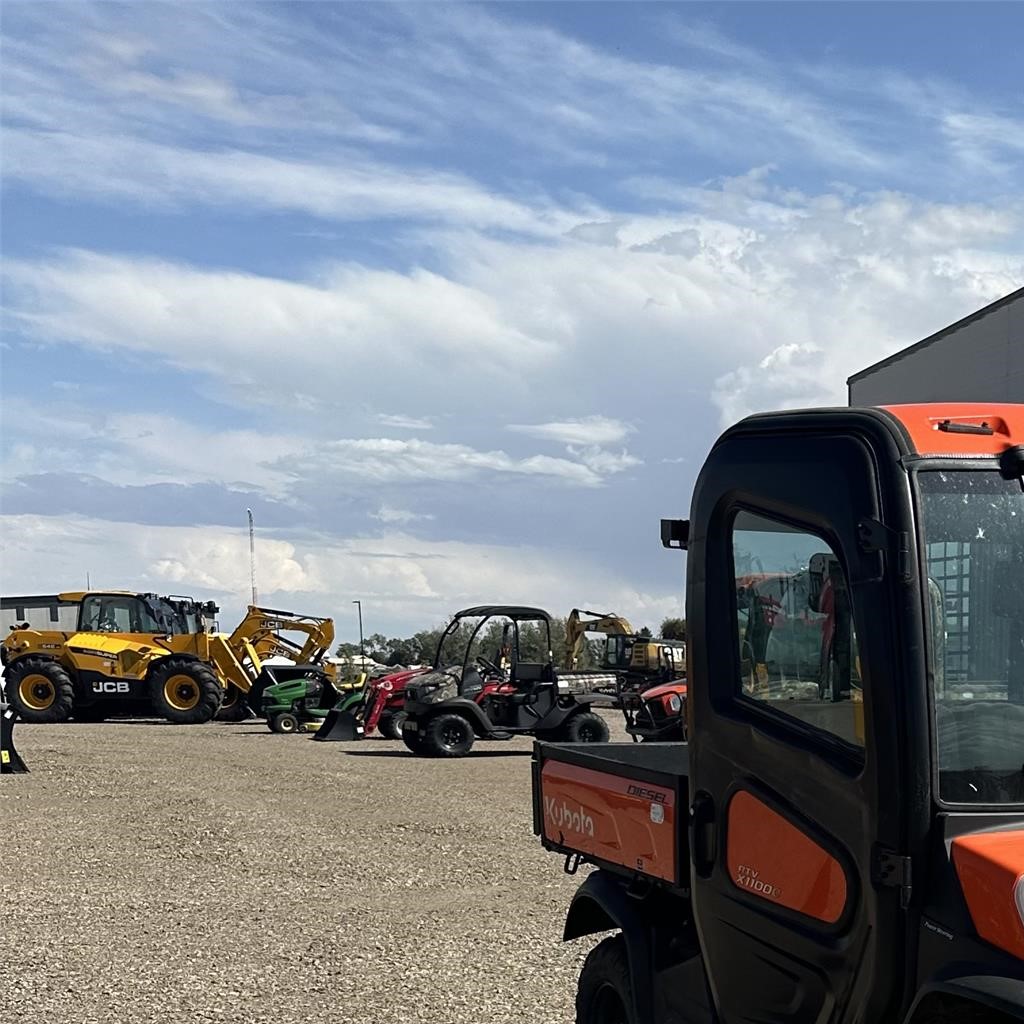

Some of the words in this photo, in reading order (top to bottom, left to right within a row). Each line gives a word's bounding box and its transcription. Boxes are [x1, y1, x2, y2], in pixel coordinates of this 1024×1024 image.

[92, 682, 130, 693] JCB
[627, 784, 669, 805] DIESEL
[544, 796, 594, 837] Kubota
[738, 865, 758, 878] RTV
